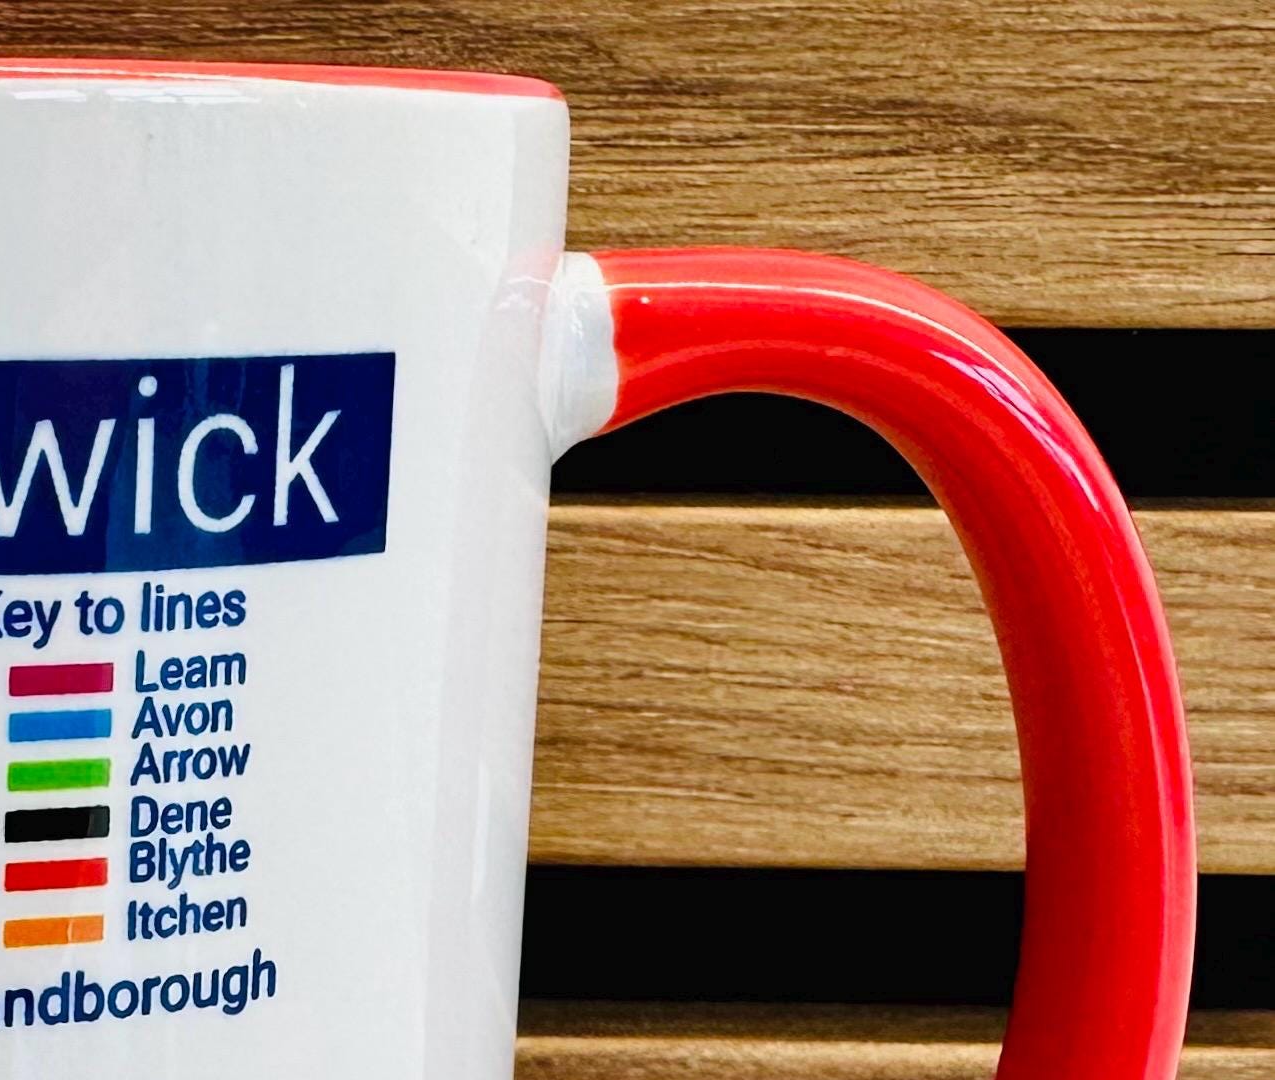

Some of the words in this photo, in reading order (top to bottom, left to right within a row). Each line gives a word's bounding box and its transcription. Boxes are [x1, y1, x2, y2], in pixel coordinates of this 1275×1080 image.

[73, 590, 125, 636] to
[141, 581, 246, 633] lines
[134, 649, 247, 693] Leam
[131, 696, 233, 740] Avon
[130, 742, 251, 787] Arrow
[130, 795, 233, 838] Dene
[129, 832, 252, 890] Blythe
[127, 892, 248, 942] Itchen
